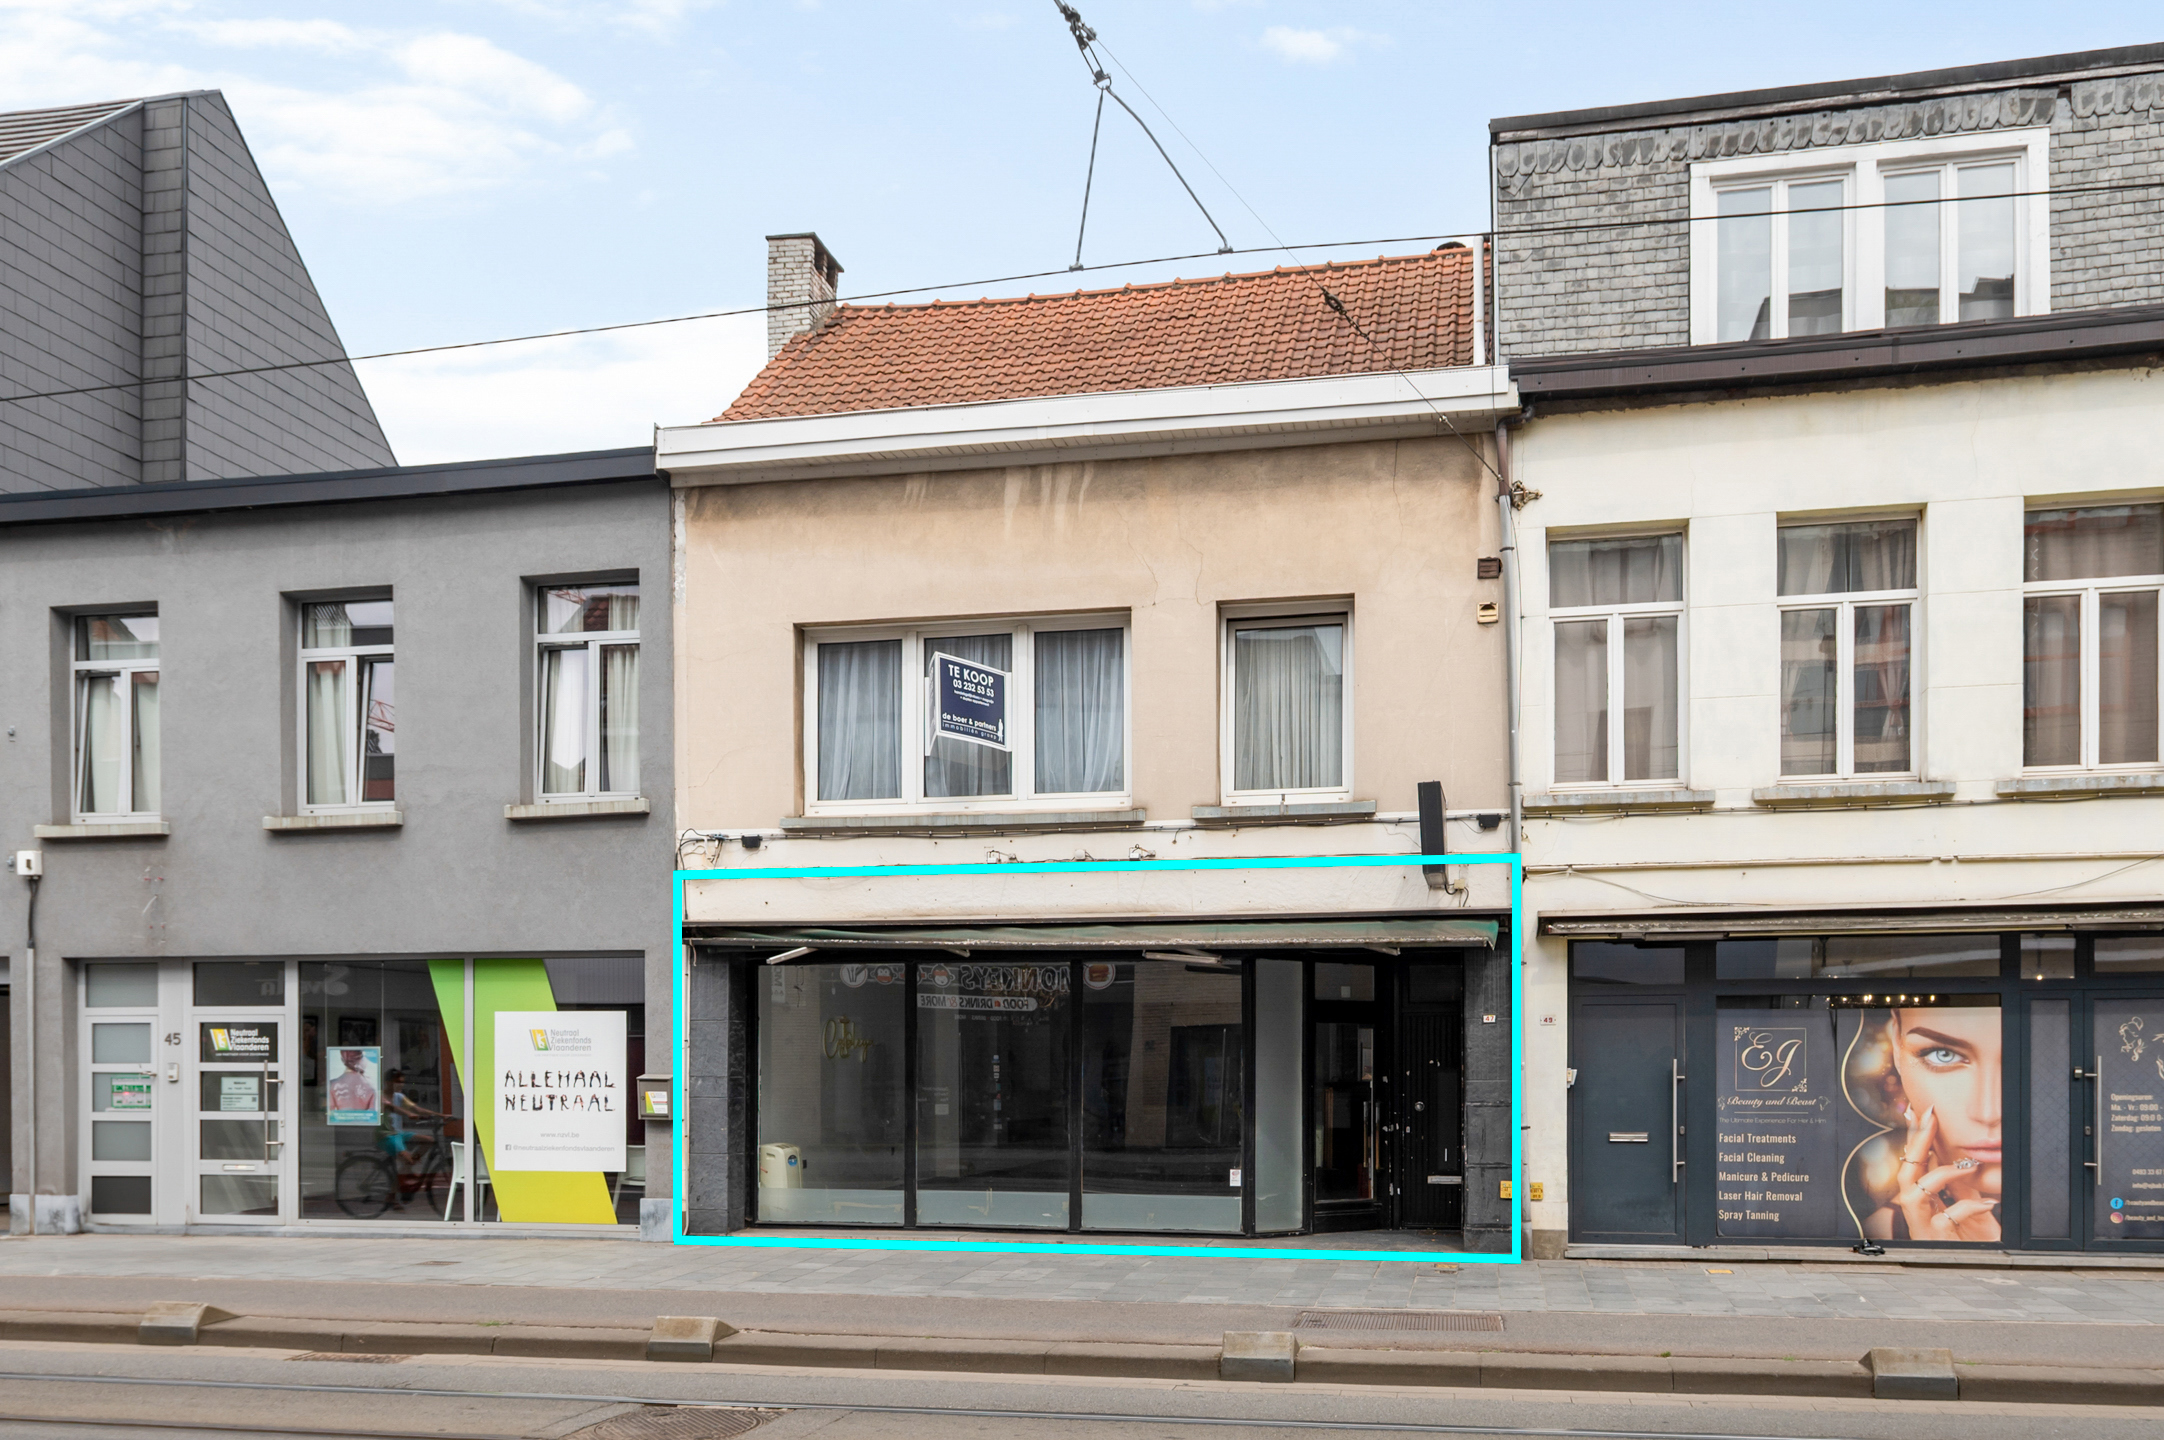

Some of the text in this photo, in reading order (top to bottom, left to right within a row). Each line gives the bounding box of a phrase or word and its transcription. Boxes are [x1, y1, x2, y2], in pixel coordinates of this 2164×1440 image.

[948, 664, 994, 687] TE KOOP
[953, 679, 962, 688] 03
[963, 682, 976, 692] 232
[977, 685, 985, 695] 53
[986, 688, 994, 698] 53
[942, 712, 951, 720] de
[952, 714, 967, 723] boer
[974, 720, 997, 732] partners
[980, 731, 997, 740] groep
[230, 1028, 259, 1037] Neutraal
[550, 1029, 579, 1037] Neutraal
[164, 1033, 181, 1046] 45
[230, 1036, 269, 1044] Ziekenfonds
[550, 1036, 592, 1044] Ziekenfonds
[229, 1043, 269, 1051] Vlaanderen
[504, 1070, 616, 1088] ALLEMAAL
[504, 1094, 616, 1112] NEUTRAAL
[1726, 1096, 1817, 1108] Beauty and Beast
[2139, 1103, 2159, 1111] 09:00
[2110, 1114, 2139, 1122] Zaterdag:
[2110, 1124, 2162, 1133] Zondag: gesloten
[1718, 1132, 1797, 1144] Facial Treatments
[1718, 1152, 1785, 1165] Facial Cleaning
[1718, 1171, 1810, 1182] Manicure & Pedicure
[1718, 1190, 1803, 1202] Laser Hair Removal
[1718, 1209, 1780, 1222] Spray Tanning
